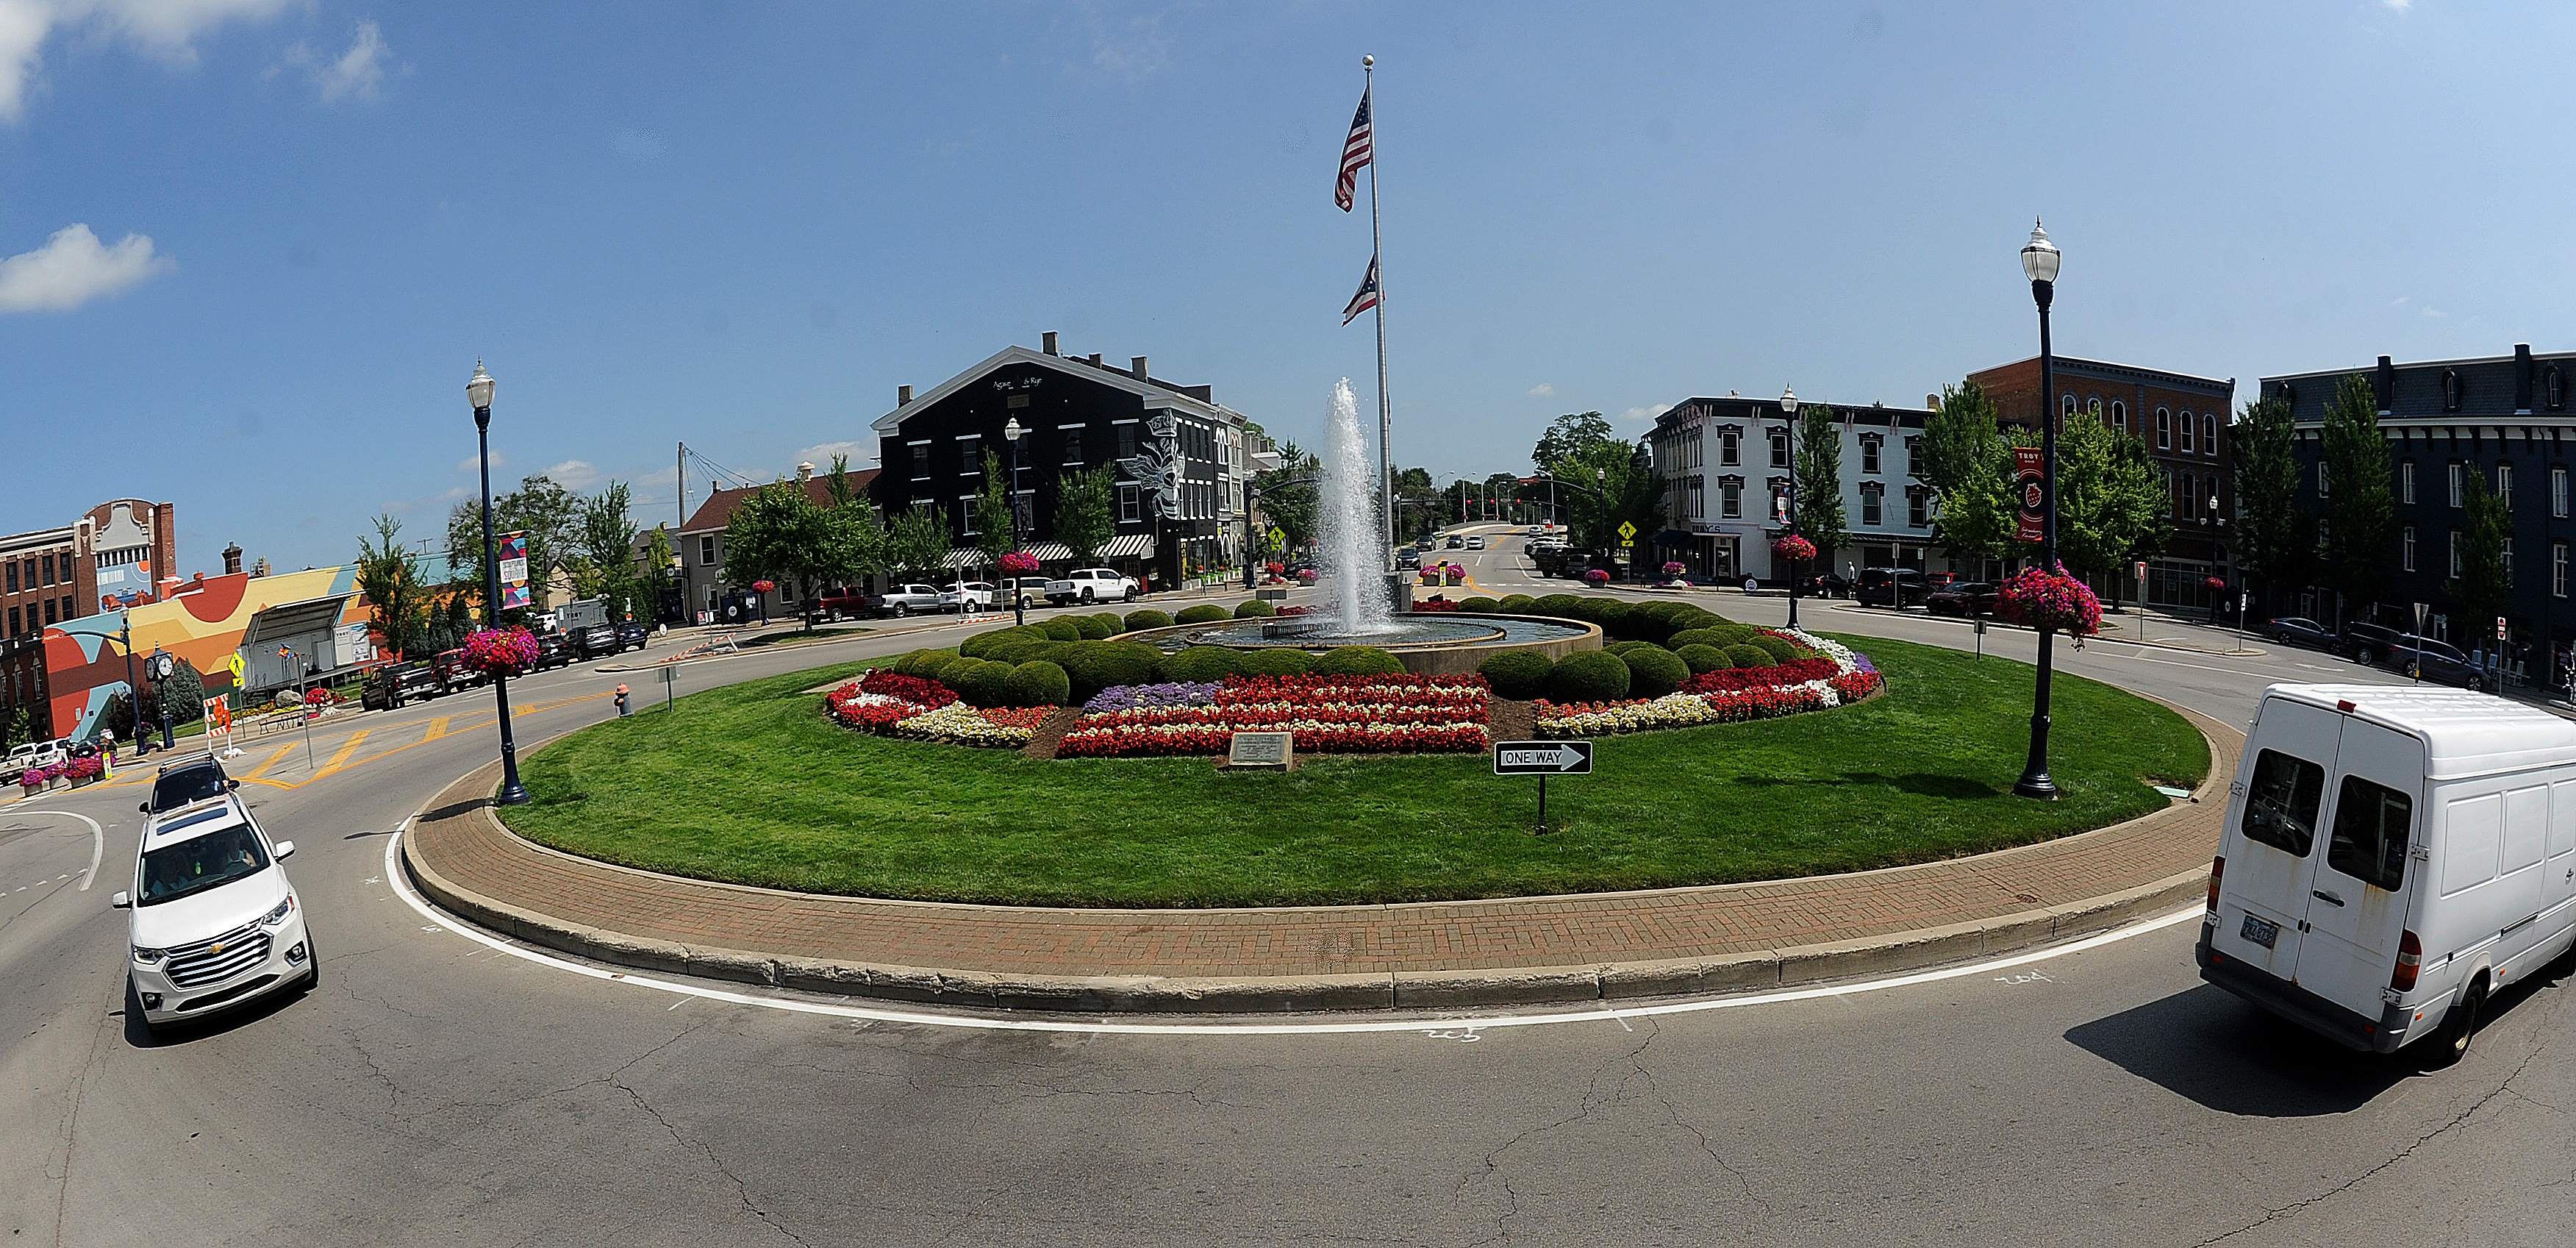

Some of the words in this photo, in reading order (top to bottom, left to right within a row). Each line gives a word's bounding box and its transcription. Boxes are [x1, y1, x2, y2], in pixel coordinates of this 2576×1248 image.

[993, 382, 1012, 391] Agave
[1031, 377, 1042, 387] Rye
[1506, 752, 1531, 764] ONE
[1536, 752, 1562, 764] WAY
